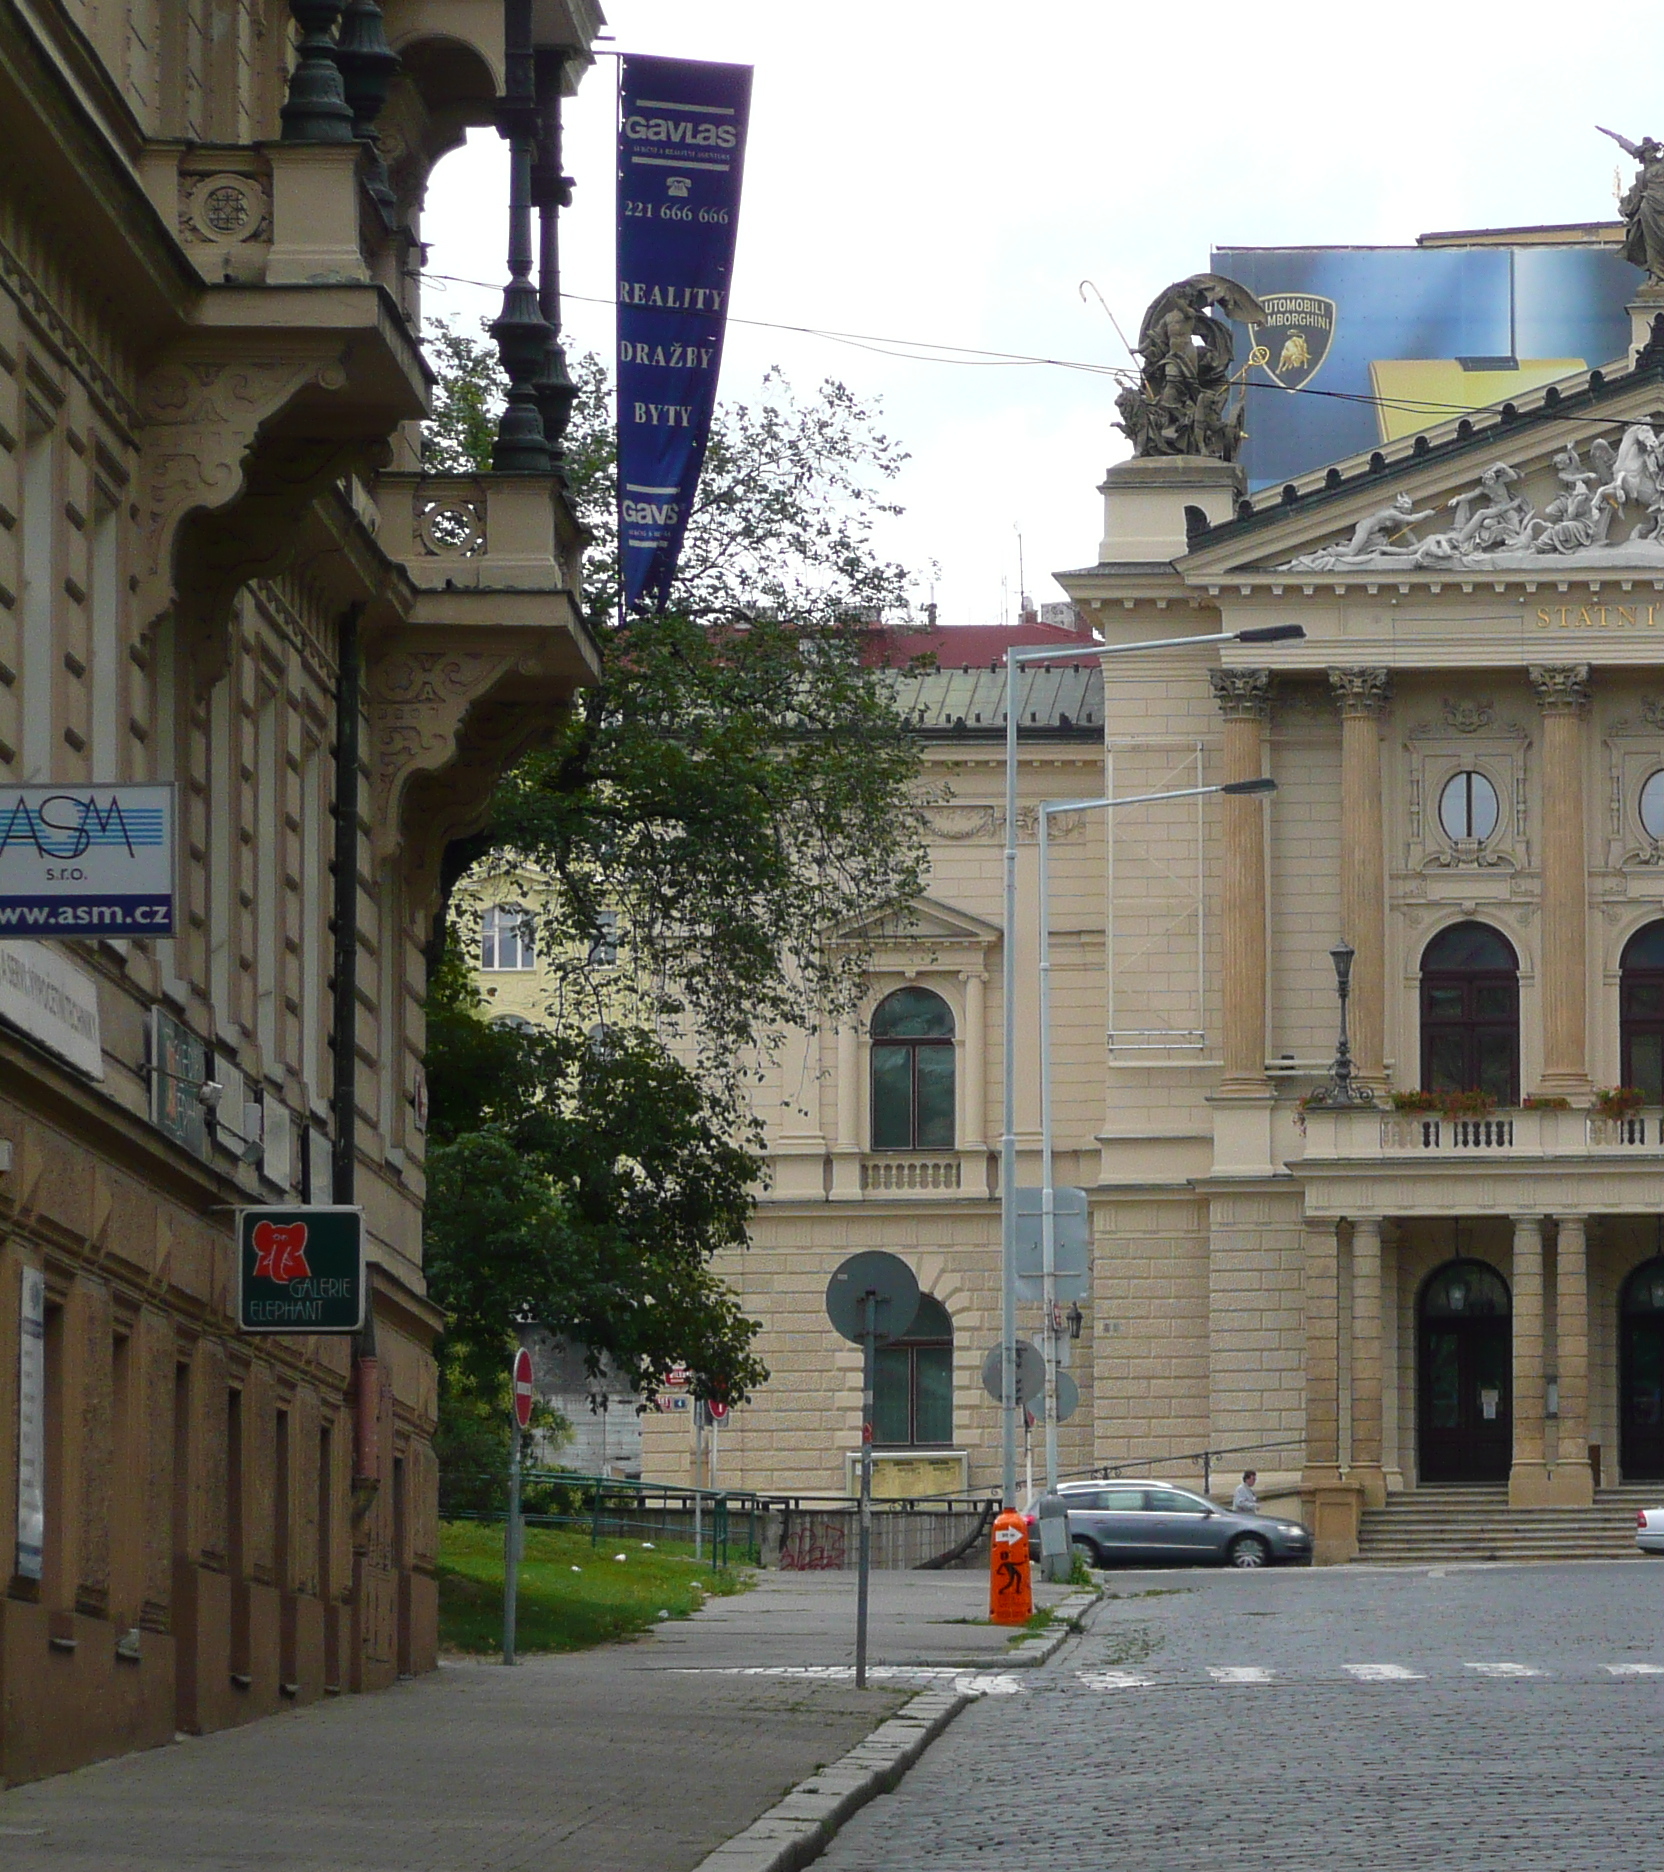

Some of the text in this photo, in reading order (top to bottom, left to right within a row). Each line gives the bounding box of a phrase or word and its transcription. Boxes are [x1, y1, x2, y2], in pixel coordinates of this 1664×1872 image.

[625, 200, 729, 224] 221 666 666
[619, 281, 726, 311] REALITY
[1261, 298, 1325, 315] UTOMOBILI
[1254, 313, 1330, 331] MBORGHINI
[620, 340, 714, 369] DRAŽBY
[634, 402, 693, 427] BYTY
[0, 795, 135, 859] ASM
[46, 867, 88, 881] s.r.o.
[289, 1278, 351, 1298] GALERIE
[250, 1301, 323, 1320] ELEPHANT
